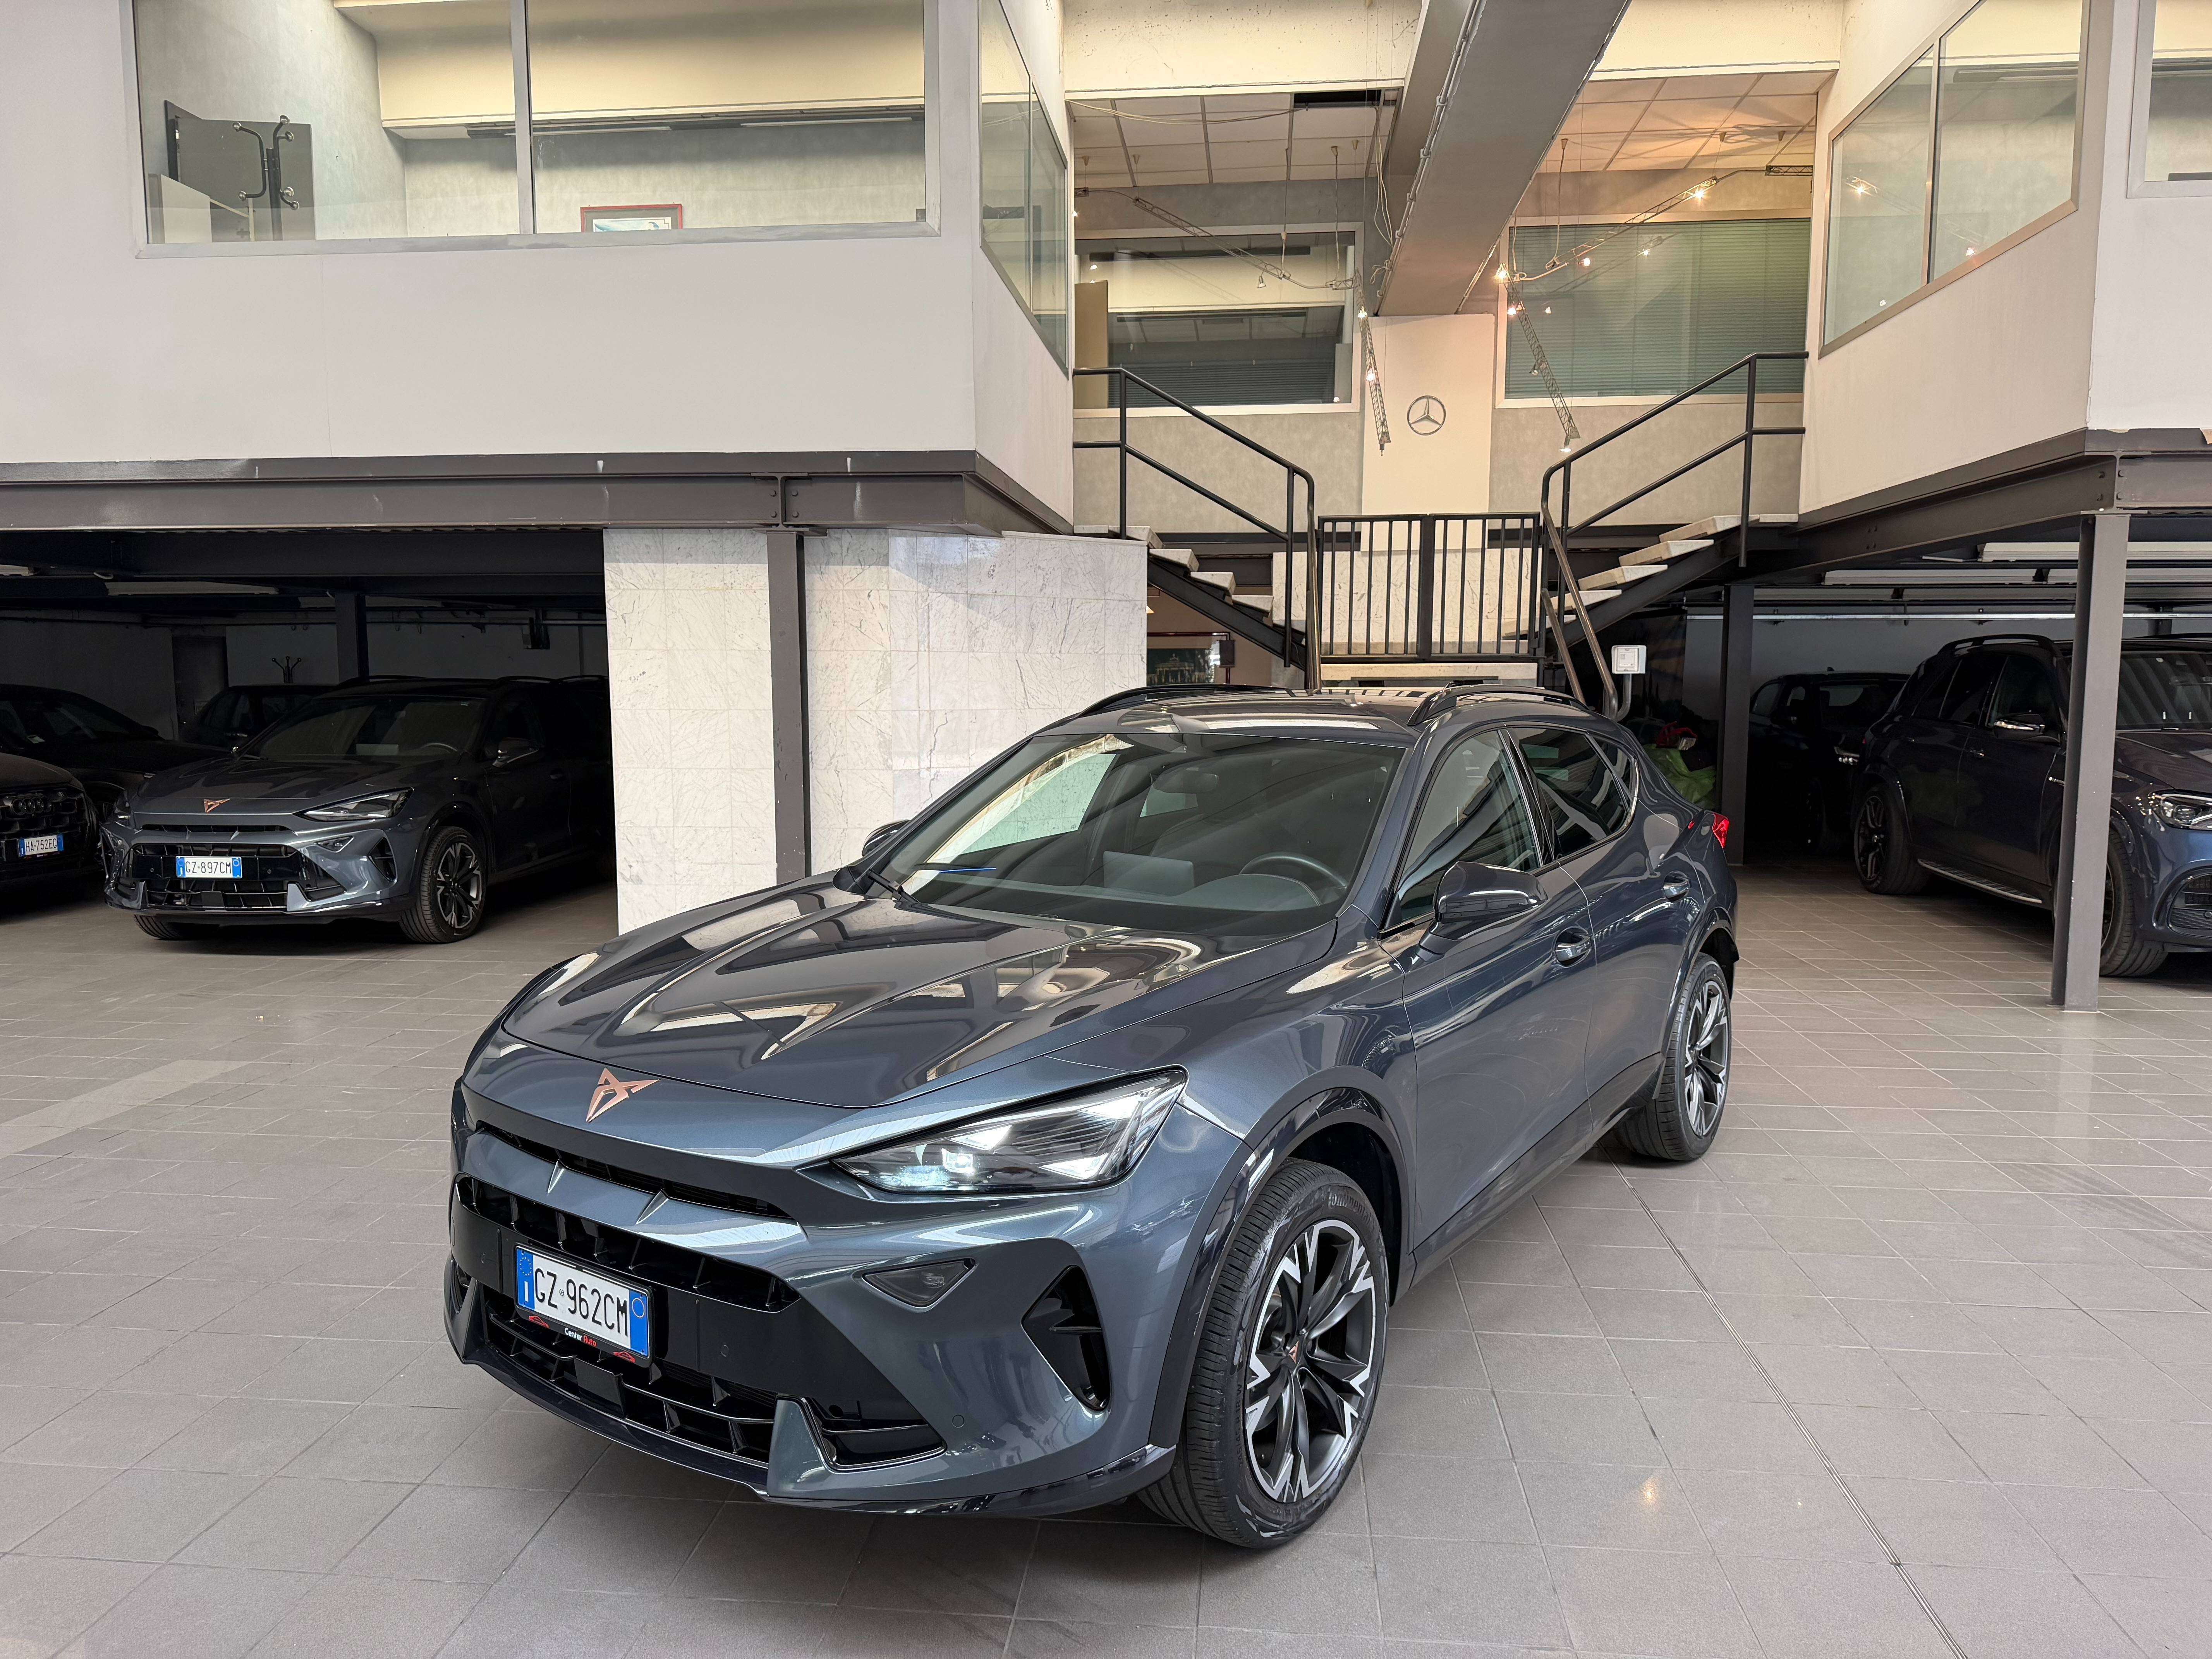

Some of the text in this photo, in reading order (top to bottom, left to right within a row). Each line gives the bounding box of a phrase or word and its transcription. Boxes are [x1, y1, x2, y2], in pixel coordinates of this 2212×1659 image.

[26, 841, 34, 852] HA
[185, 861, 197, 873] GZ
[201, 862, 231, 874] 897CM
[524, 1268, 628, 1336] I GZ 962CM
[565, 1328, 597, 1347] Center Auto
